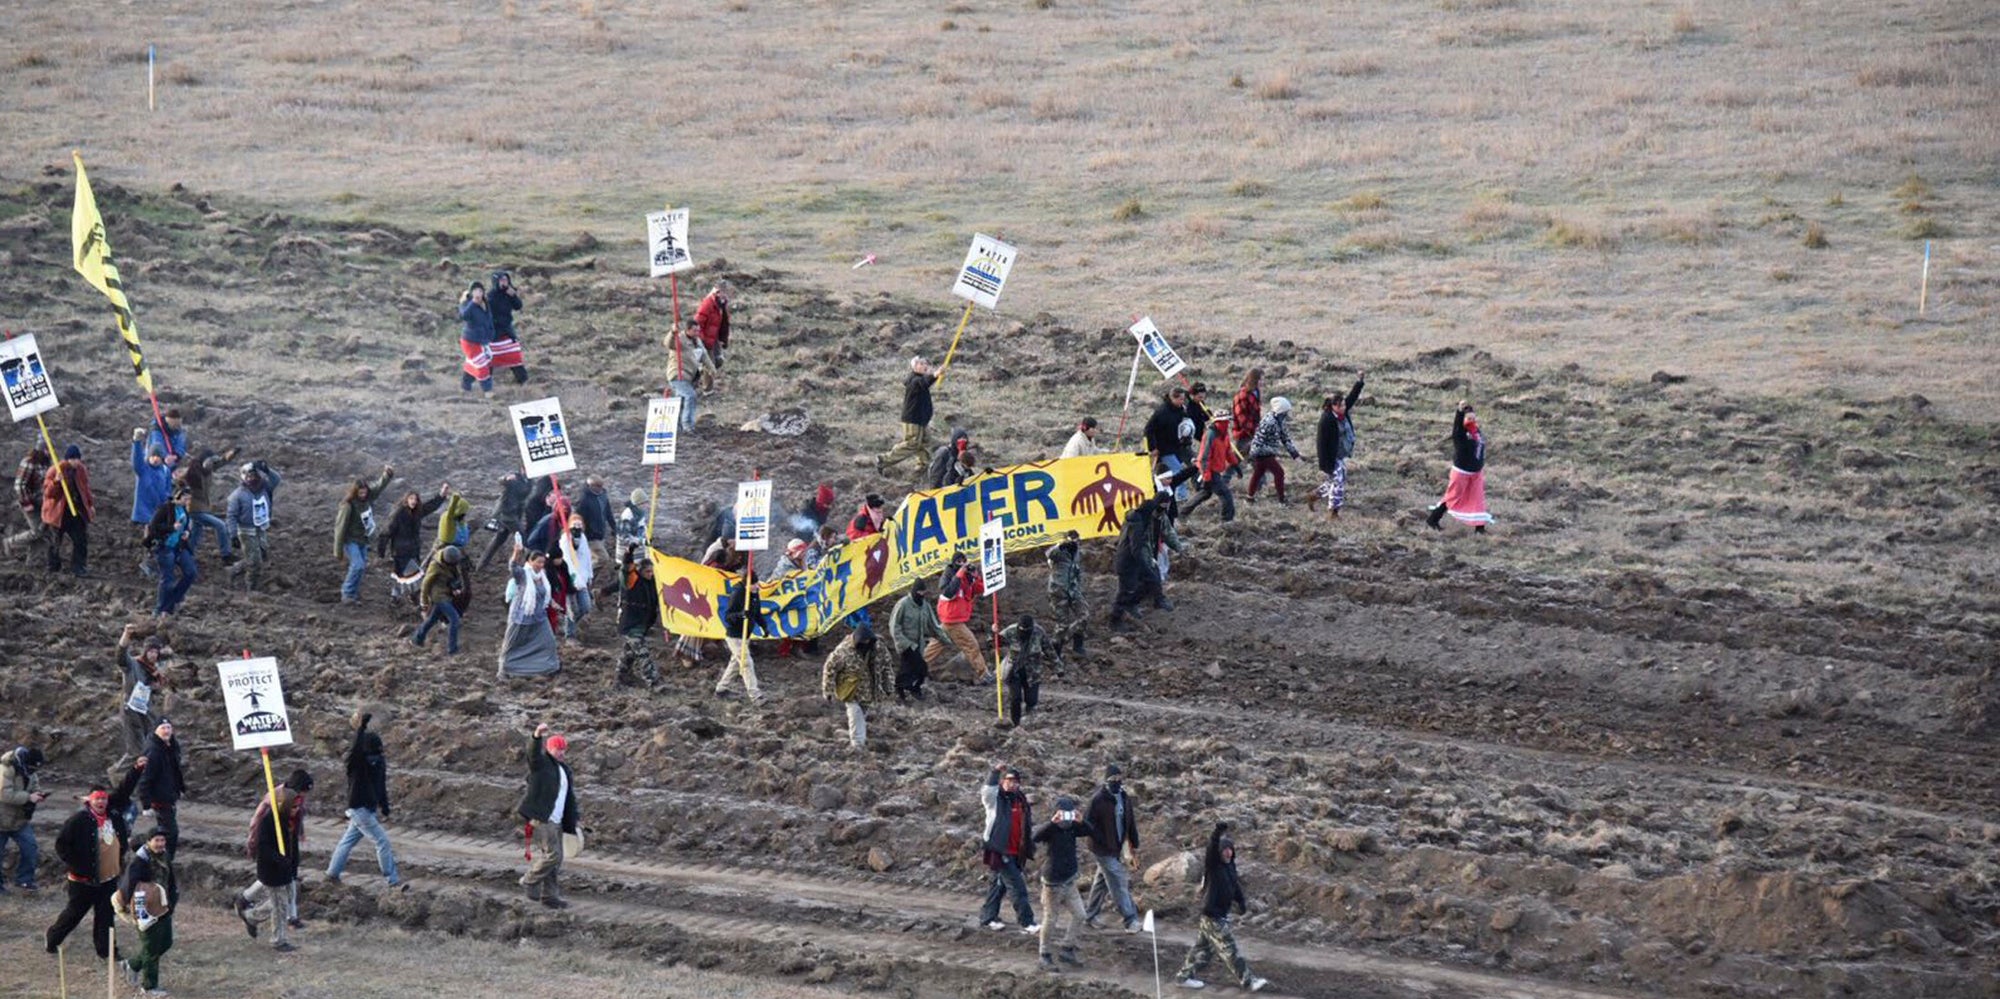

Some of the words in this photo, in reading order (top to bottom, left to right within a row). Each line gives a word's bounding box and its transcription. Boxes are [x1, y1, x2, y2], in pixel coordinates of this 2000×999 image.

[980, 247, 1008, 264] WATER
[9, 375, 44, 394] DEFEND
[14, 386, 49, 406] SACRED
[528, 435, 563, 448] DEFEND
[531, 447, 566, 460] SACRED
[915, 550, 940, 567] LIFE
[1002, 523, 1045, 542] ICONI
[228, 674, 273, 688] PROTECT
[243, 714, 281, 727] WATER
